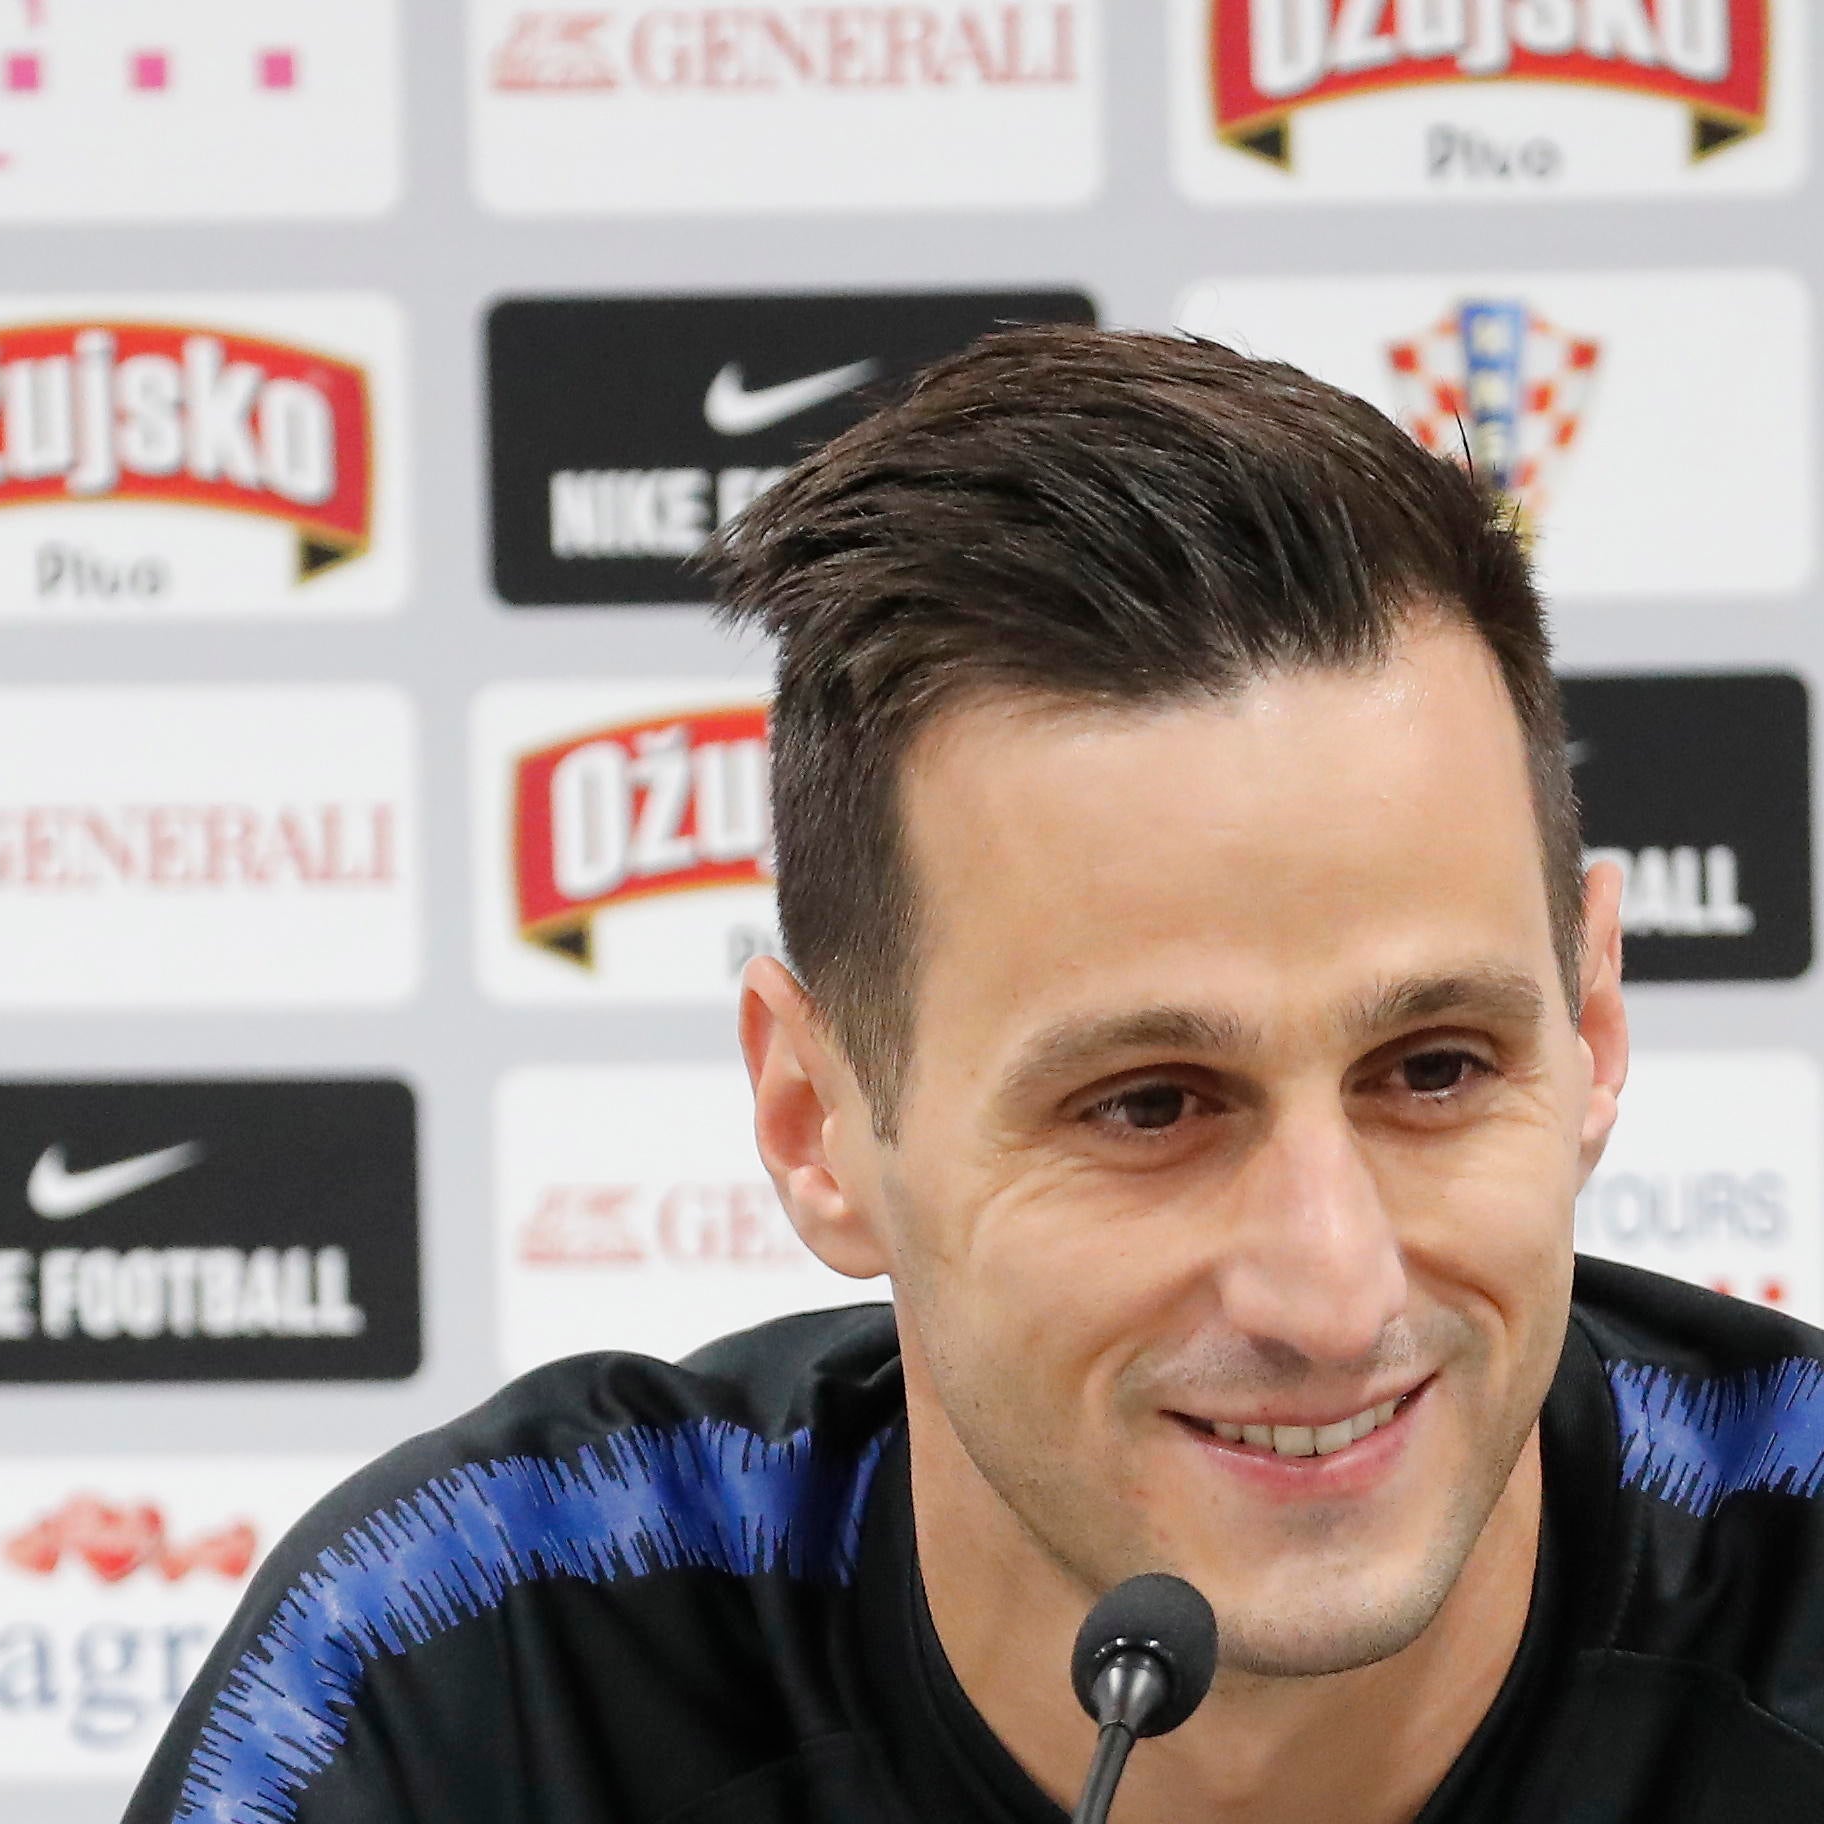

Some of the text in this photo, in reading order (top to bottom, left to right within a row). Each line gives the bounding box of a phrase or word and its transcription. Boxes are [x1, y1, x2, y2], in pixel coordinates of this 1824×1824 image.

[629, 0, 1077, 92] GENERALI
[548, 466, 714, 561] NIKE
[40, 1243, 367, 1342] FOOTBALL
